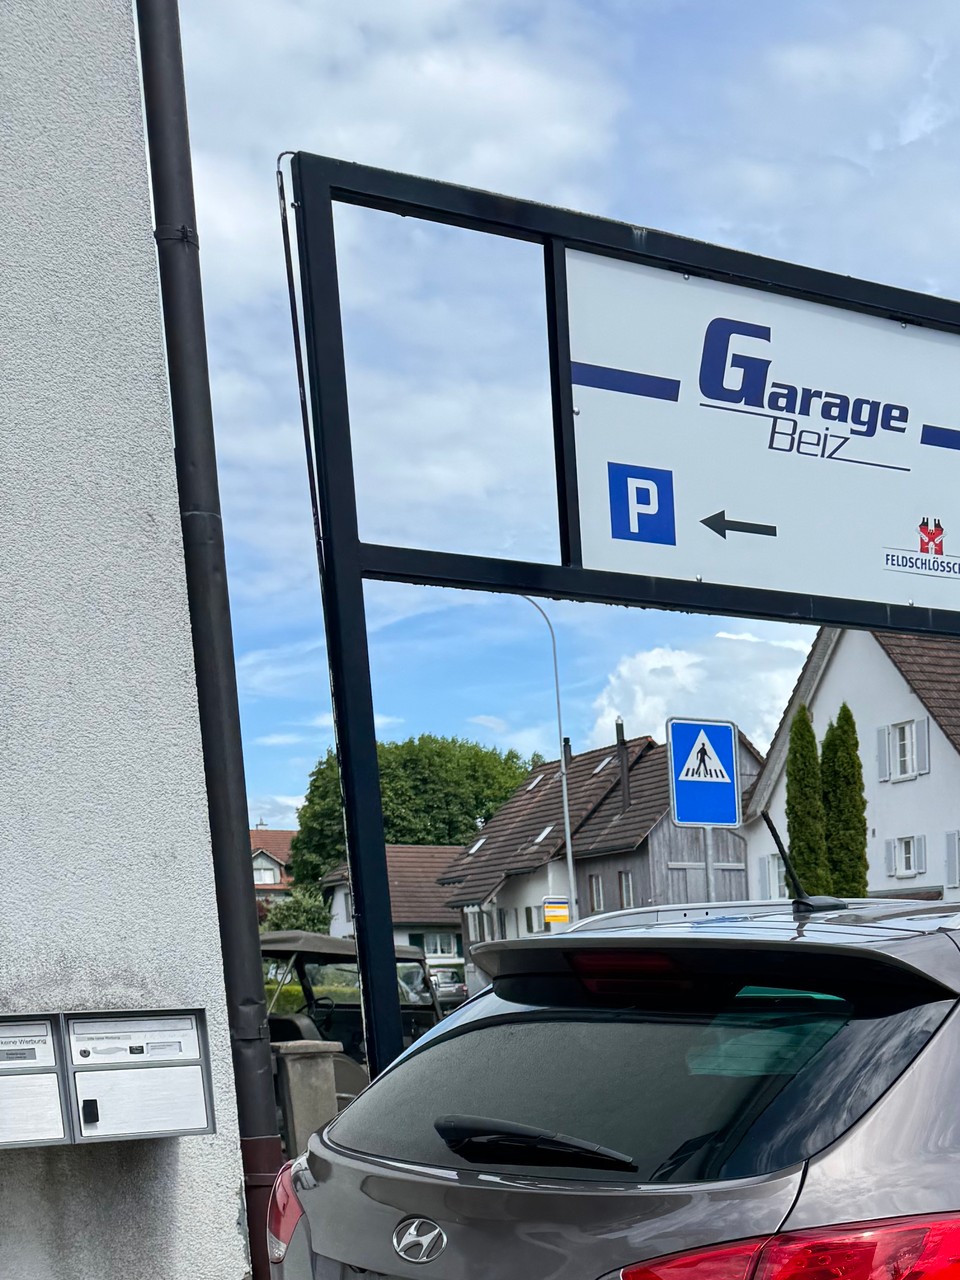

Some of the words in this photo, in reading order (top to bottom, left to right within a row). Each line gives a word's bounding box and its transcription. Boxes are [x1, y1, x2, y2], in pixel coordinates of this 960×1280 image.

[698, 316, 910, 438] Garage
[767, 416, 852, 461] Beiz
[626, 476, 659, 534] P
